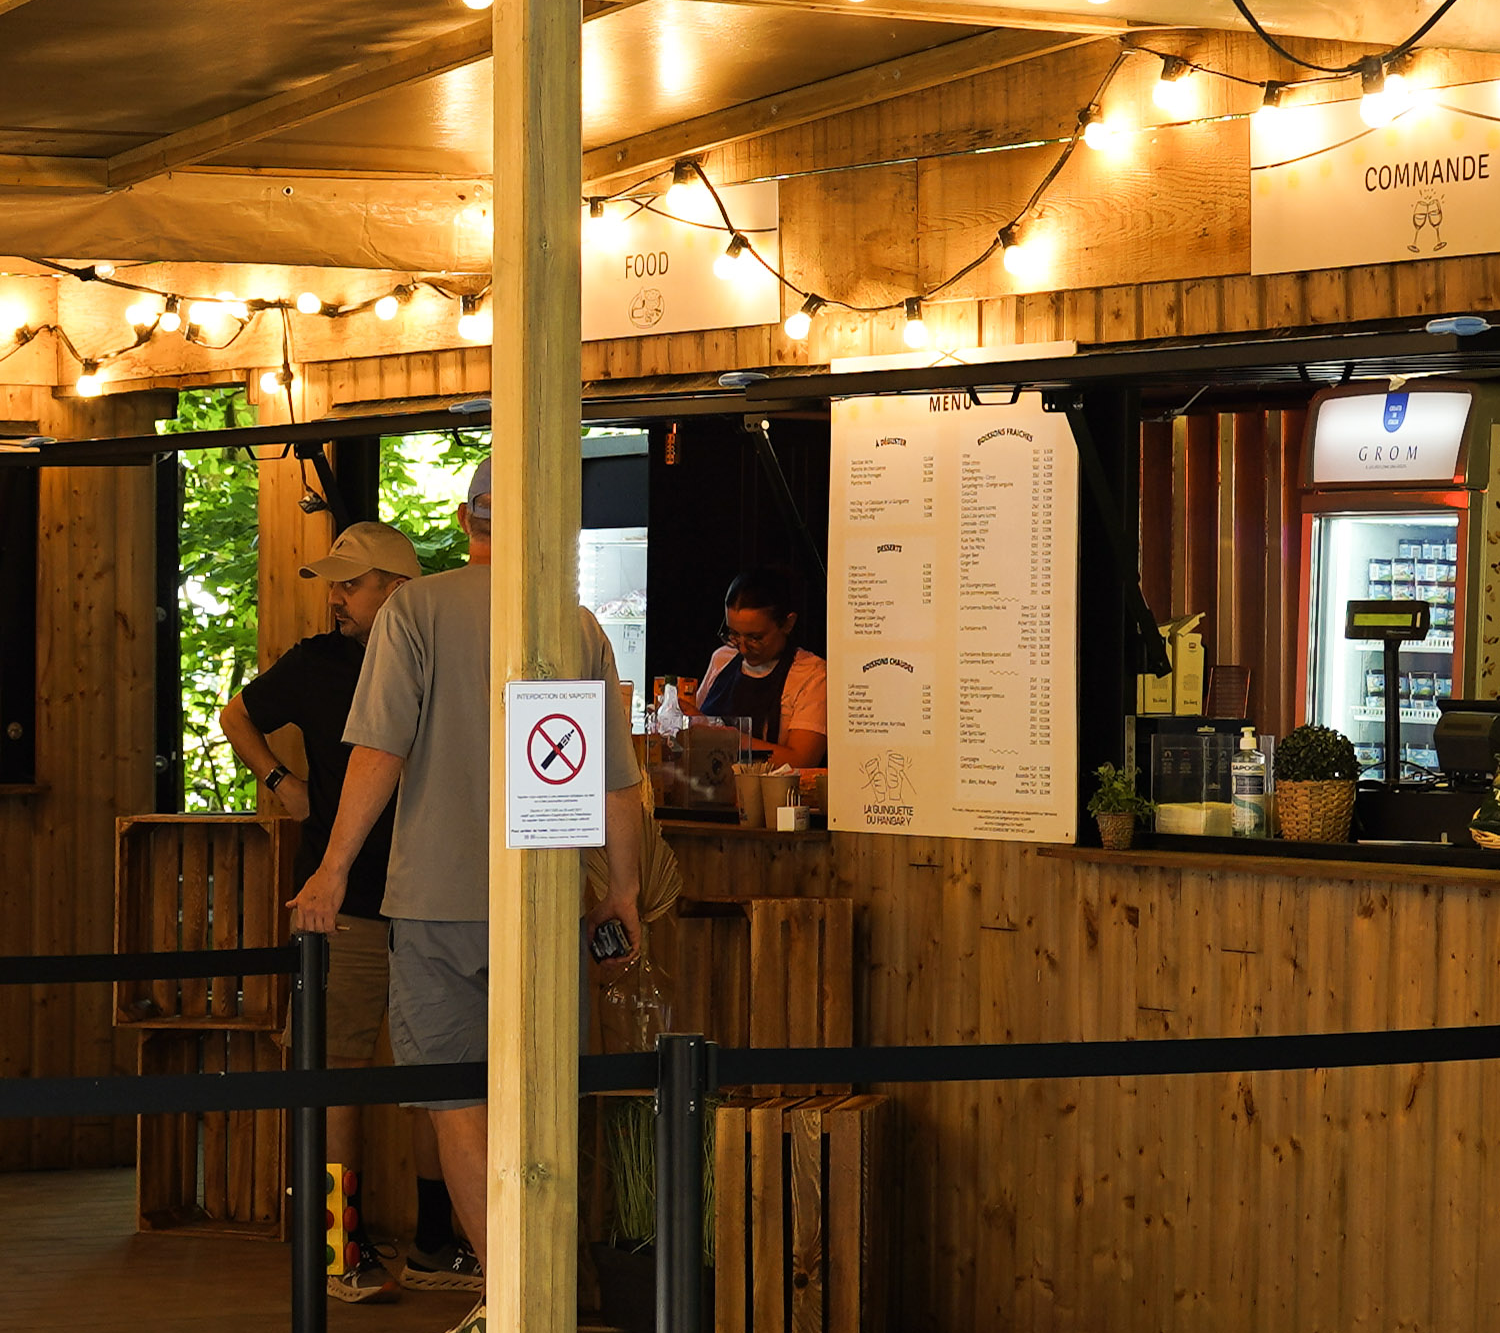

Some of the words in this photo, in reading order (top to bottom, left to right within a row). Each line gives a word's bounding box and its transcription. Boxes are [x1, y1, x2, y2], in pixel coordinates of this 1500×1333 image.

[1365, 153, 1490, 192] COMMANDE
[625, 251, 669, 279] FOOD
[930, 393, 972, 412] MENU
[1358, 445, 1419, 462] GROM
[864, 804, 872, 814] LA
[866, 815, 876, 824] DU
